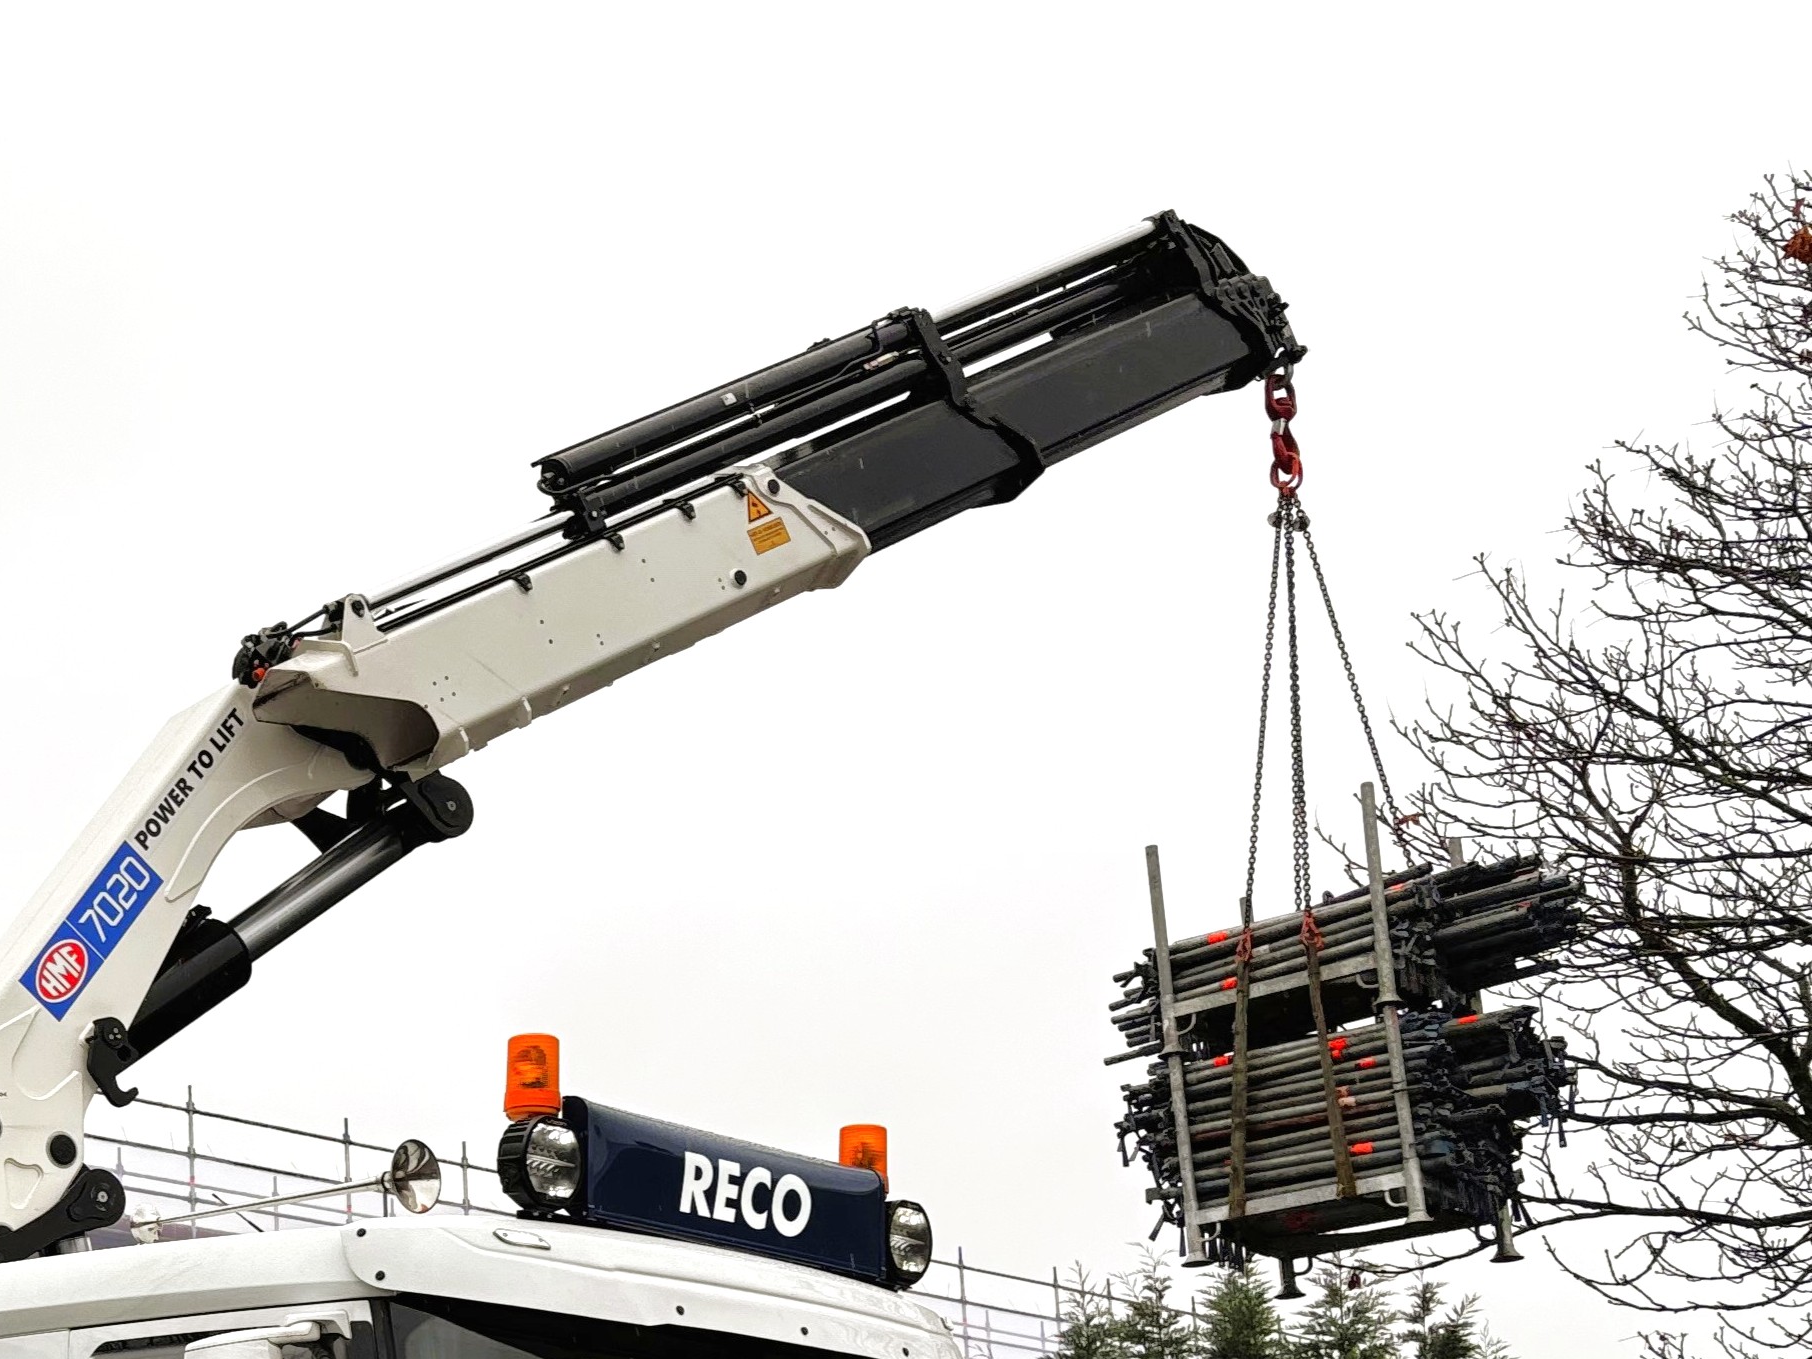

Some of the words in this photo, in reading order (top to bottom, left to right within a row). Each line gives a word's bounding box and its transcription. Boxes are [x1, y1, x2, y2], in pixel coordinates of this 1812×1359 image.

[134, 776, 195, 852] POWER
[187, 749, 214, 781] TO
[209, 707, 244, 754] LIFT
[78, 855, 151, 944] 7020
[40, 945, 83, 998] HMF
[679, 1150, 812, 1238] RECO
